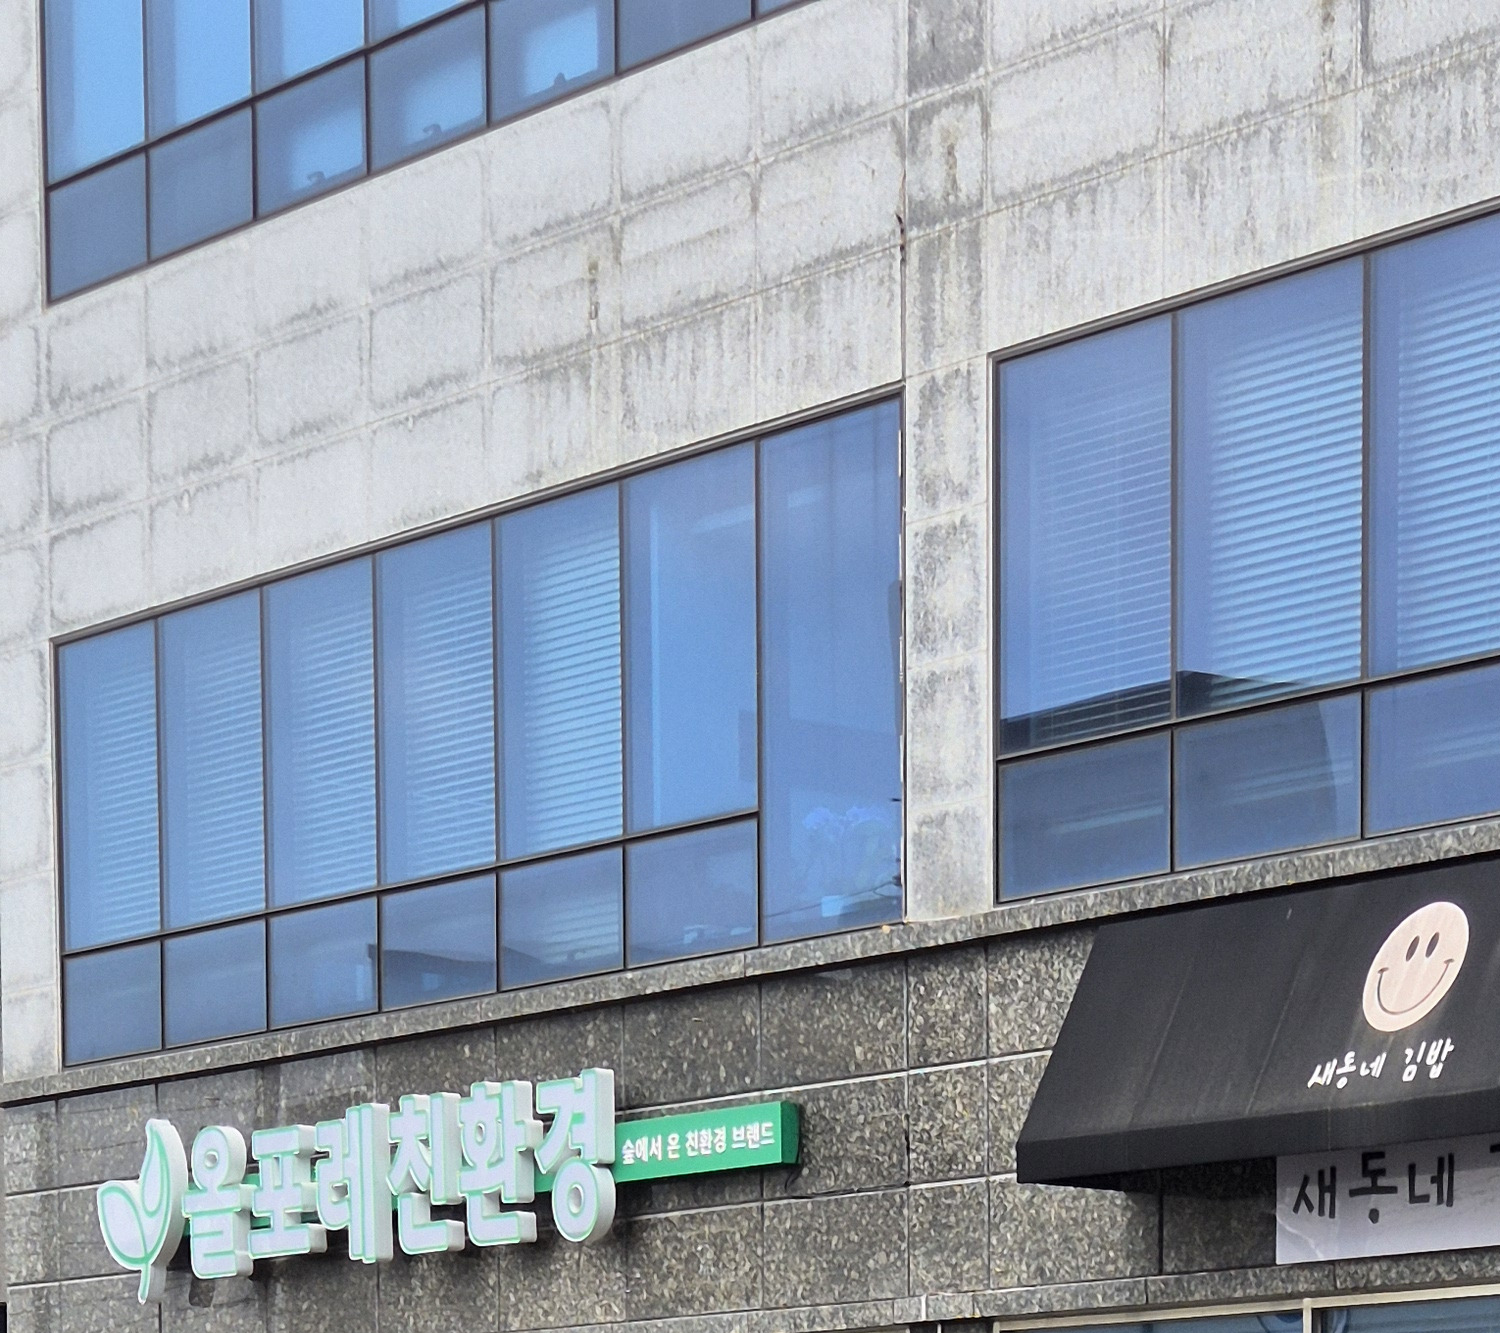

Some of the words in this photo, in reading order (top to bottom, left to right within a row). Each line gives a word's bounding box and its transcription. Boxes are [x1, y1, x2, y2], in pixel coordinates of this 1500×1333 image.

[1307, 1051, 1387, 1089] 새동네
[1402, 1038, 1454, 1082] 김밥
[622, 1134, 662, 1165] 숲에서
[685, 1126, 727, 1156] 친환경
[731, 1121, 775, 1149] 브랜드
[1293, 1151, 1454, 1224] 새동네
